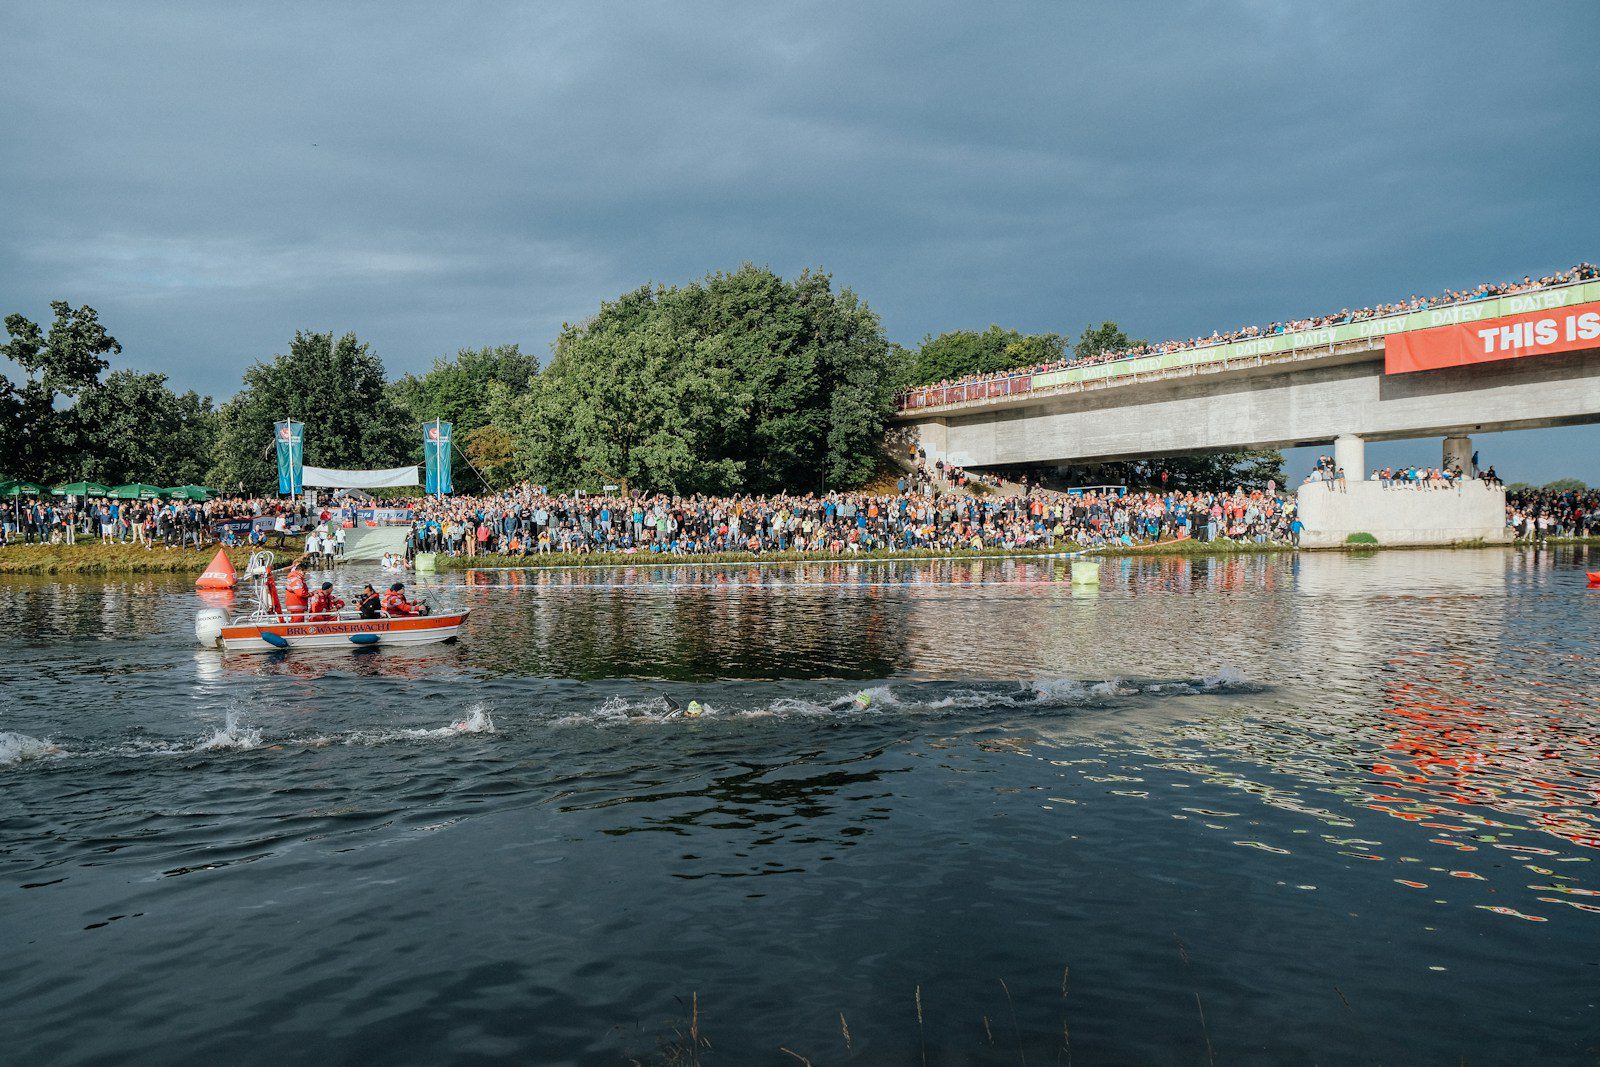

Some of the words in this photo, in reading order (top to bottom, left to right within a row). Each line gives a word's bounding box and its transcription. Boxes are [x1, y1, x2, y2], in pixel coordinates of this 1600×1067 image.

[1510, 289, 1569, 314] DATEV
[1431, 304, 1485, 326] DATEV
[1360, 317, 1408, 335] DATEV
[1478, 318, 1558, 354] THIS
[1566, 312, 1600, 343] IS
[1293, 328, 1338, 346] DATEV
[1235, 340, 1275, 356] DATEV
[197, 614, 223, 622] HONDA
[286, 626, 309, 636] BRK
[317, 622, 391, 634] WASSERWACHT
